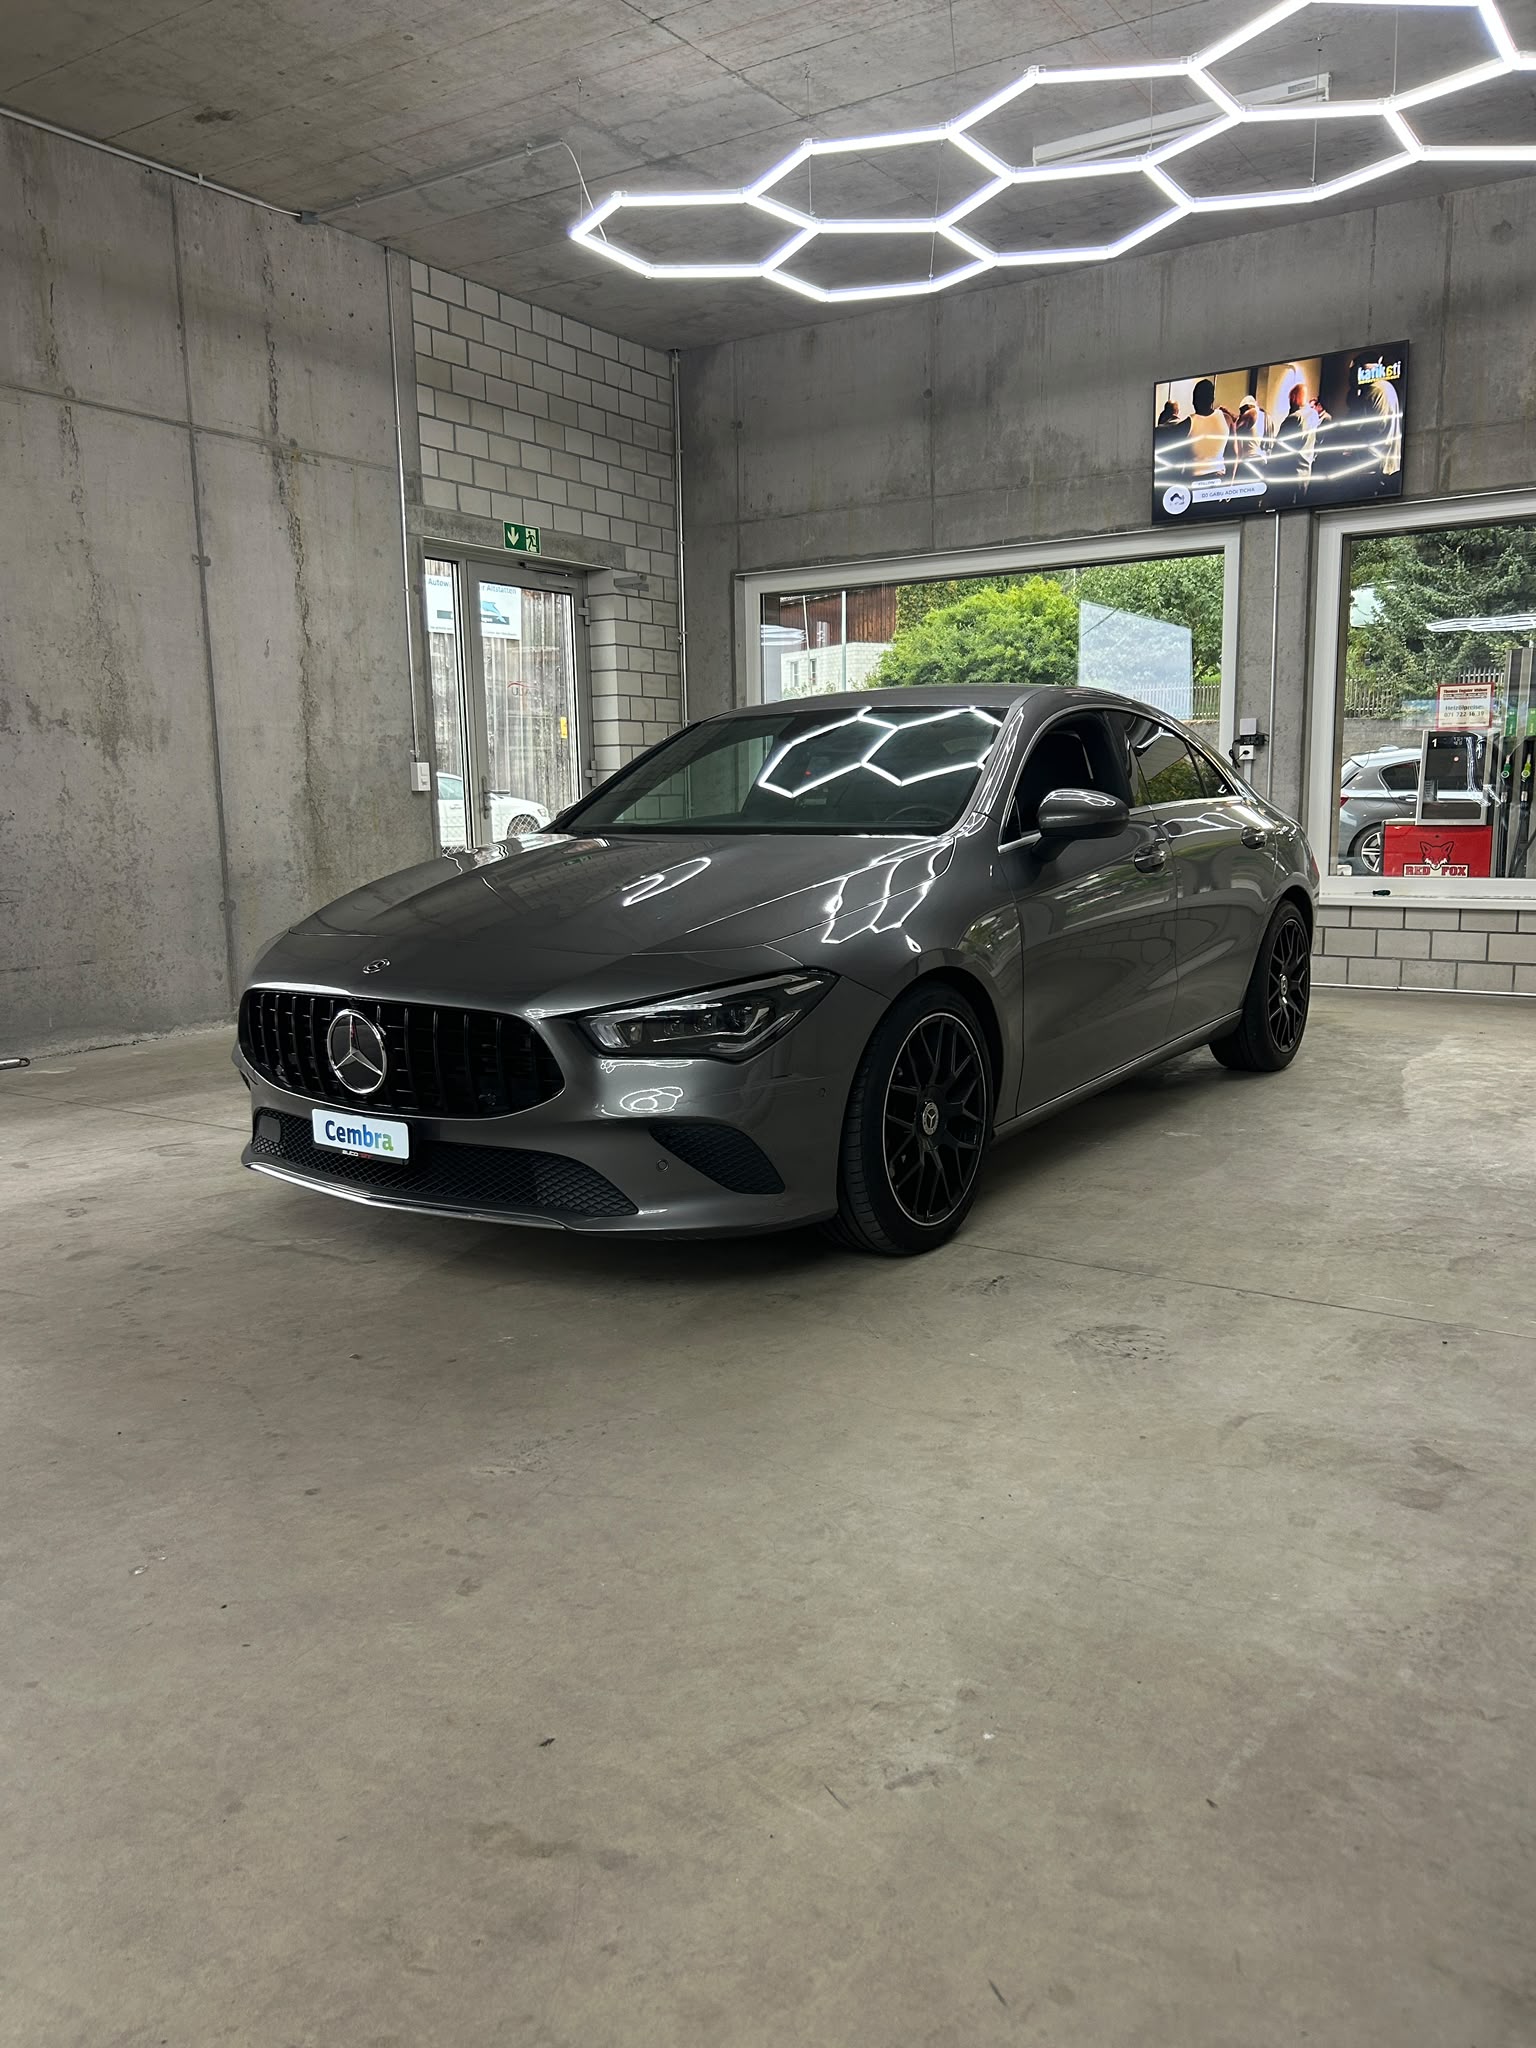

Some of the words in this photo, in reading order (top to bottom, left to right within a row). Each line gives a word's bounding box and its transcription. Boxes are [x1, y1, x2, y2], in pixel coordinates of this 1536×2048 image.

[428, 578, 450, 587] Autow
[1431, 738, 1437, 748] 1
[1405, 865, 1431, 876] RED
[1441, 866, 1466, 876] FOX
[325, 1120, 394, 1151] Cembra
